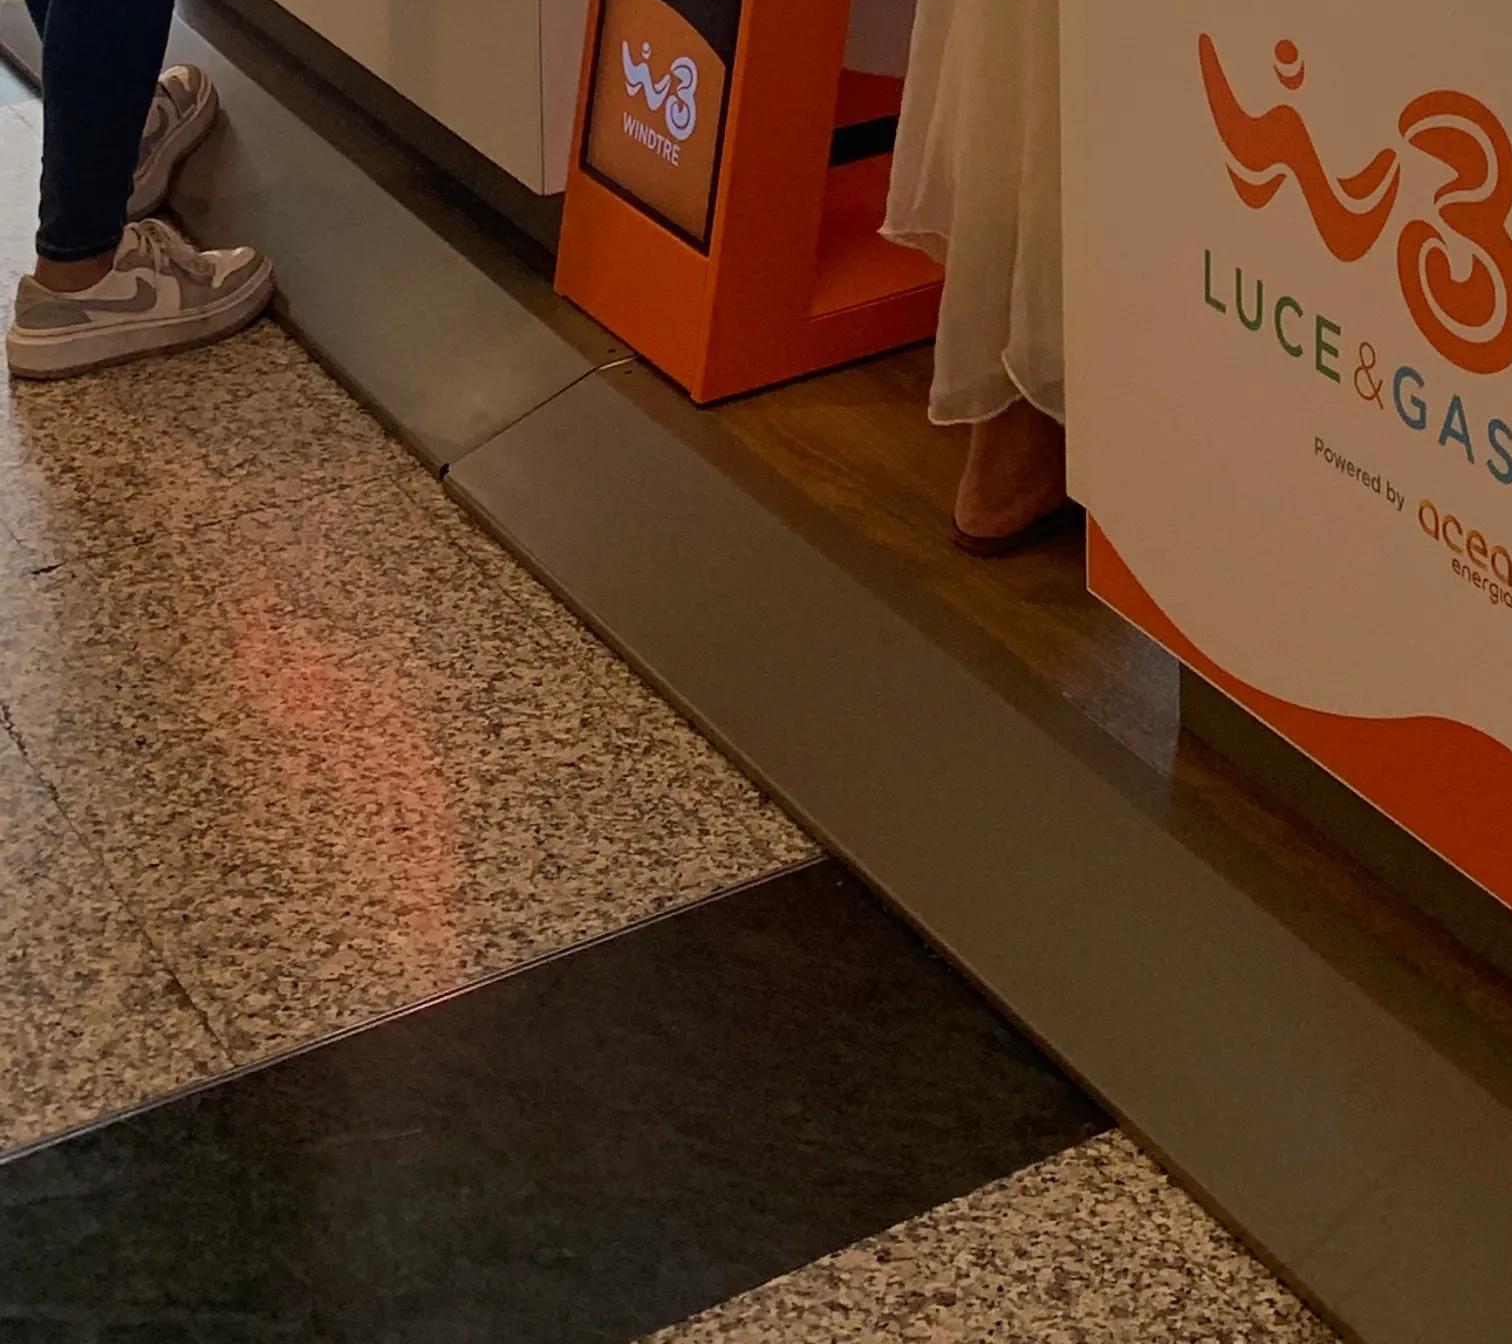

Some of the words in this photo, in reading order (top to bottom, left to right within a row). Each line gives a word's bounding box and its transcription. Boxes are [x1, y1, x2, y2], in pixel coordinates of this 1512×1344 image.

[622, 112, 681, 167] WINDTRE
[1314, 436, 1381, 495] Powered
[1386, 479, 1406, 512] by
